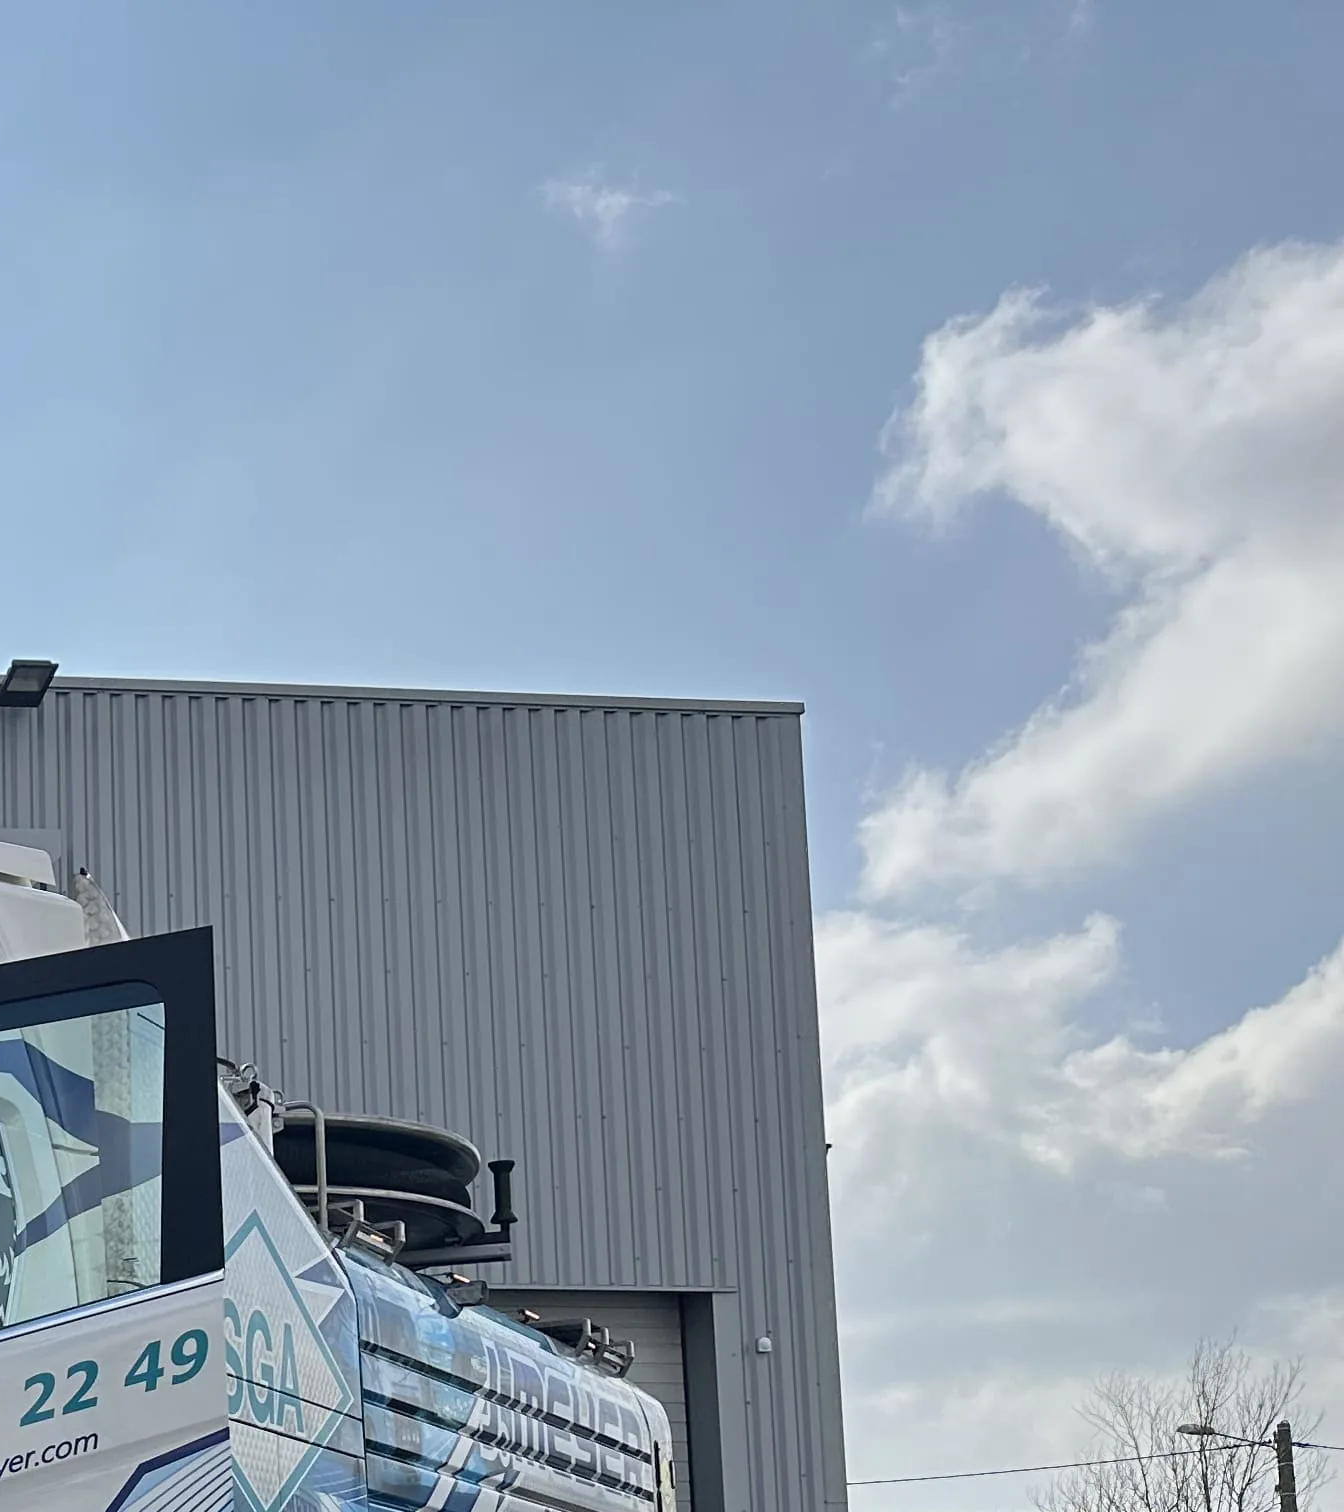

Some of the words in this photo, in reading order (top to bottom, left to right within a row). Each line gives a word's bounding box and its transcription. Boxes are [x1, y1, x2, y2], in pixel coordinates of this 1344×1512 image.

[19, 1360, 99, 1427] 22
[124, 1329, 210, 1393] 49
[224, 1298, 305, 1435] SGA
